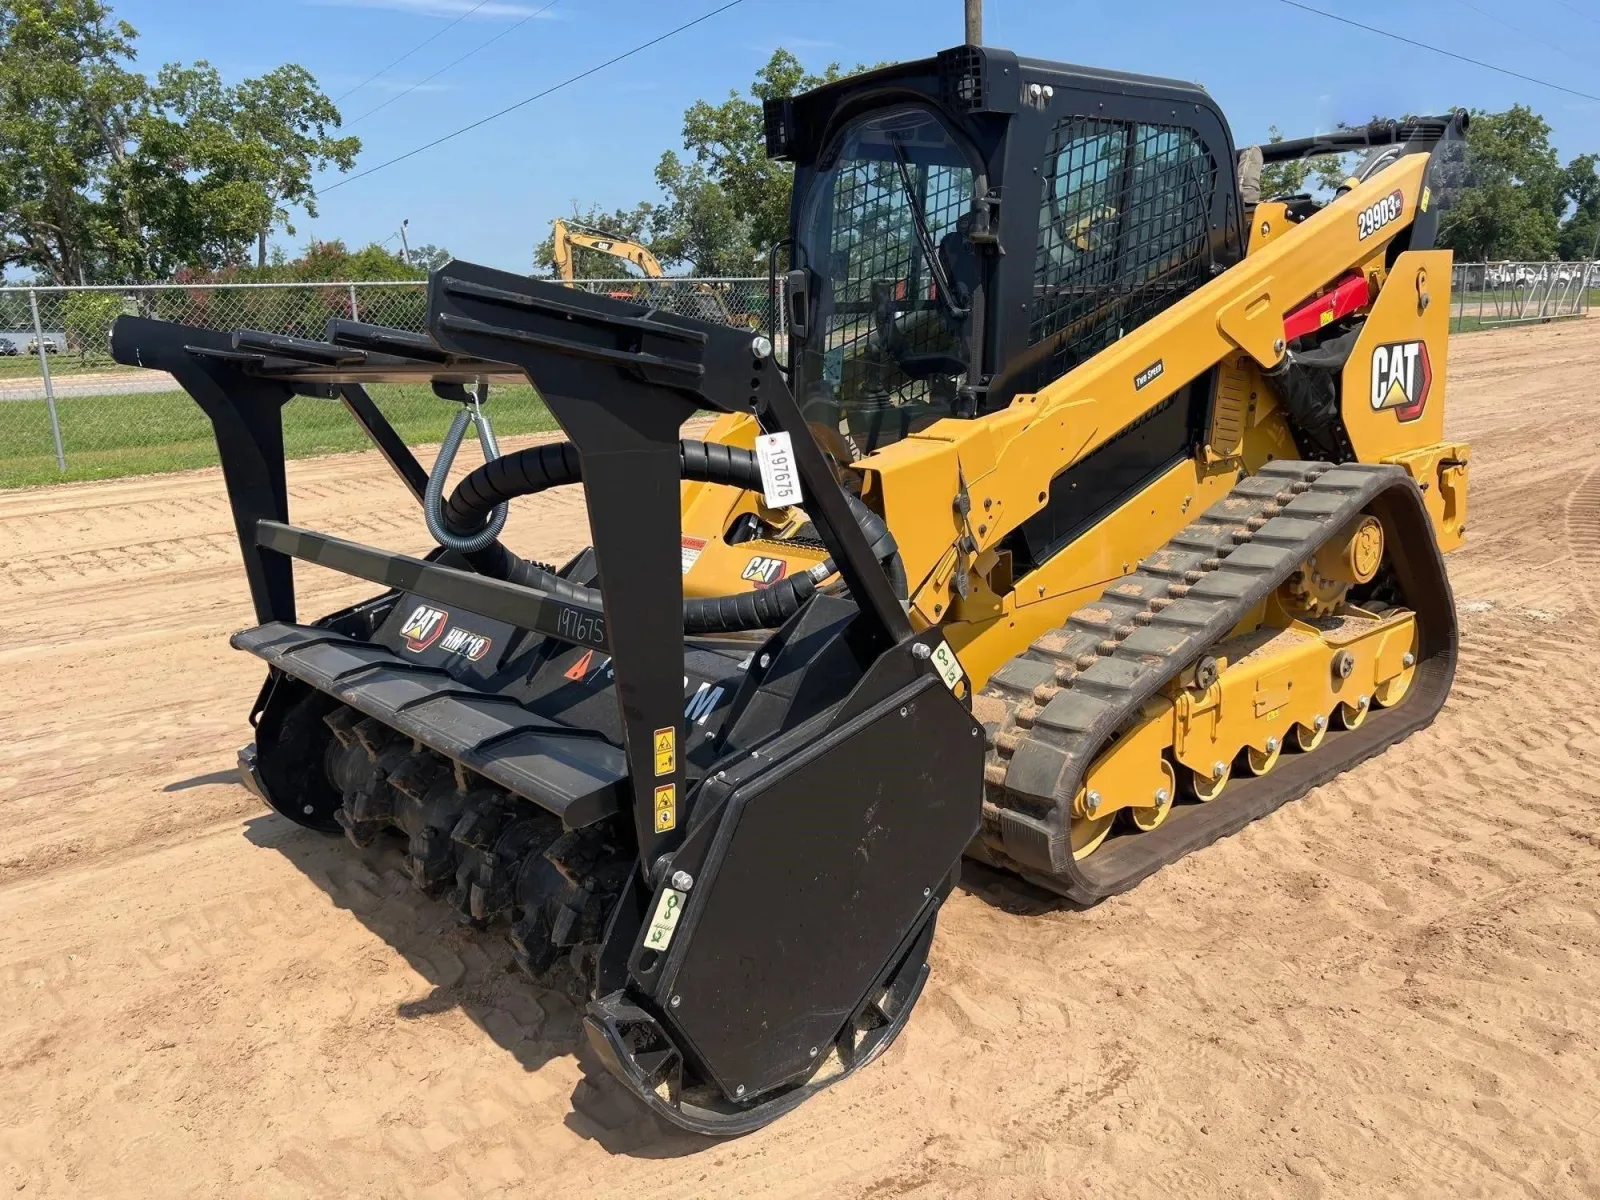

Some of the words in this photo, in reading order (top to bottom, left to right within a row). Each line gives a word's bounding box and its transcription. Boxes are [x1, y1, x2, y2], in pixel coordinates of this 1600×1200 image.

[1358, 195, 1396, 240] 299D3
[598, 242, 609, 250] CAT
[1371, 343, 1419, 408] CAT
[770, 449, 794, 497] 197675
[742, 556, 782, 582] CAT
[401, 606, 444, 640] CAT
[557, 607, 604, 643] 197675
[441, 628, 486, 657] HM418
